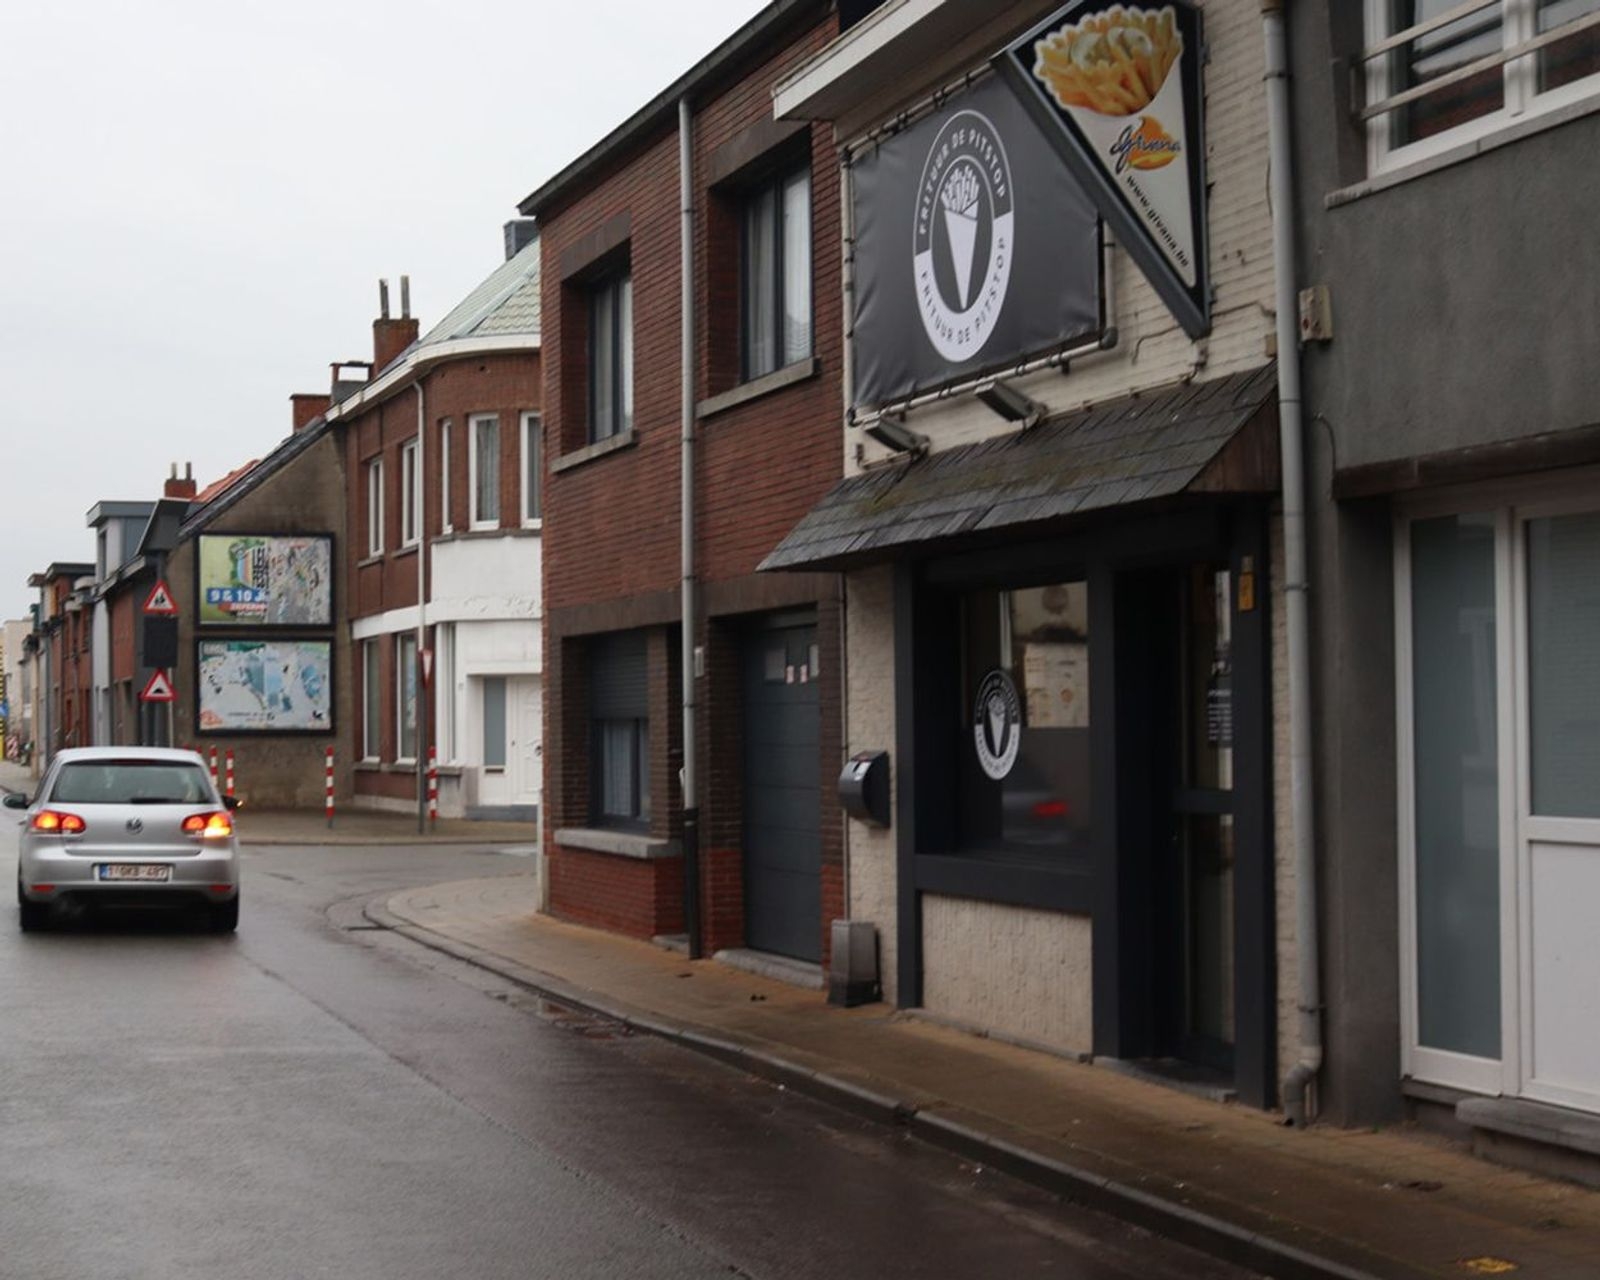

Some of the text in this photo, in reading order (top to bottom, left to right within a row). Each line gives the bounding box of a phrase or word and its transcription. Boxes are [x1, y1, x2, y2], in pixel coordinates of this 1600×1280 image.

[919, 128, 1006, 235] FRITUUR DE PITSTOP
[1126, 175, 1189, 267] www.givana.be
[957, 325, 970, 345] DE
[210, 589, 220, 602] 9
[236, 589, 252, 602] 10
